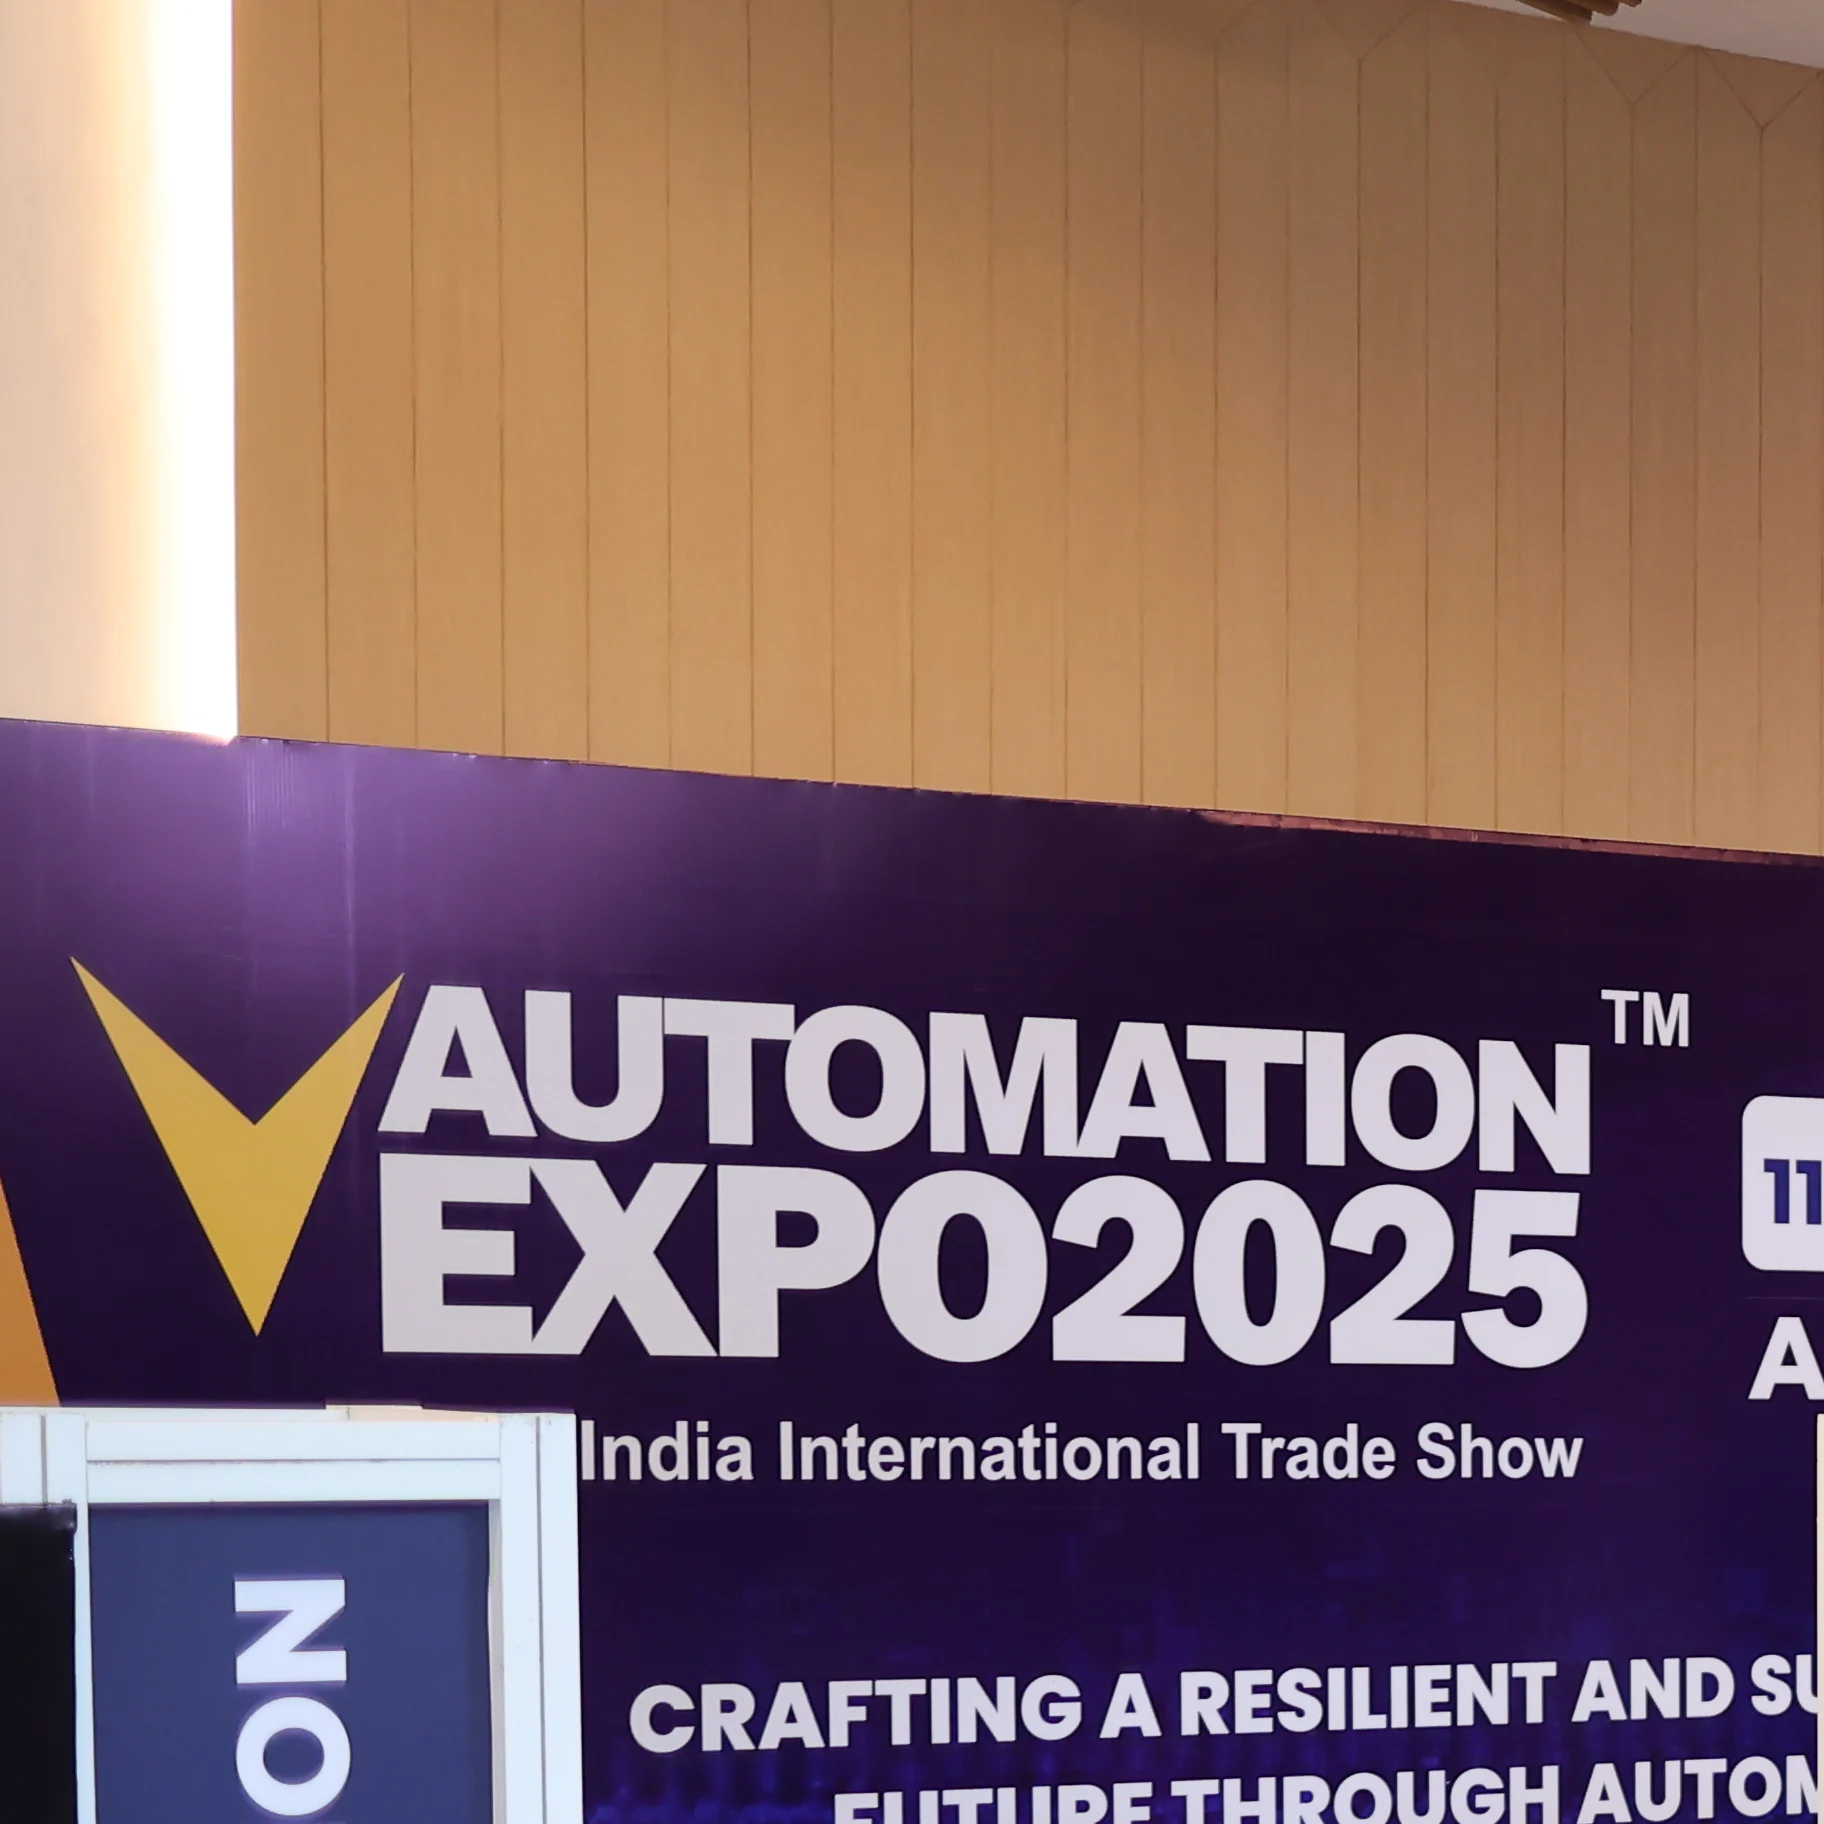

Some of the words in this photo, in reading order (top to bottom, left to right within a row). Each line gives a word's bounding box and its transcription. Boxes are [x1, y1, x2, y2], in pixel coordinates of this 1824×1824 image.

[1601, 988, 1689, 1047] TM
[378, 984, 1591, 1175] AUTOMATION
[380, 1152, 1588, 1369] EXPO2025
[580, 1419, 754, 1482] India
[780, 1421, 1199, 1482] International
[1222, 1422, 1396, 1481] Trade
[1416, 1424, 1584, 1480] Show
[630, 1674, 1083, 1754] CRAFTING
[1099, 1671, 1163, 1739] A
[1180, 1660, 1558, 1736] RESILIENT
[1571, 1655, 1735, 1723] AND
